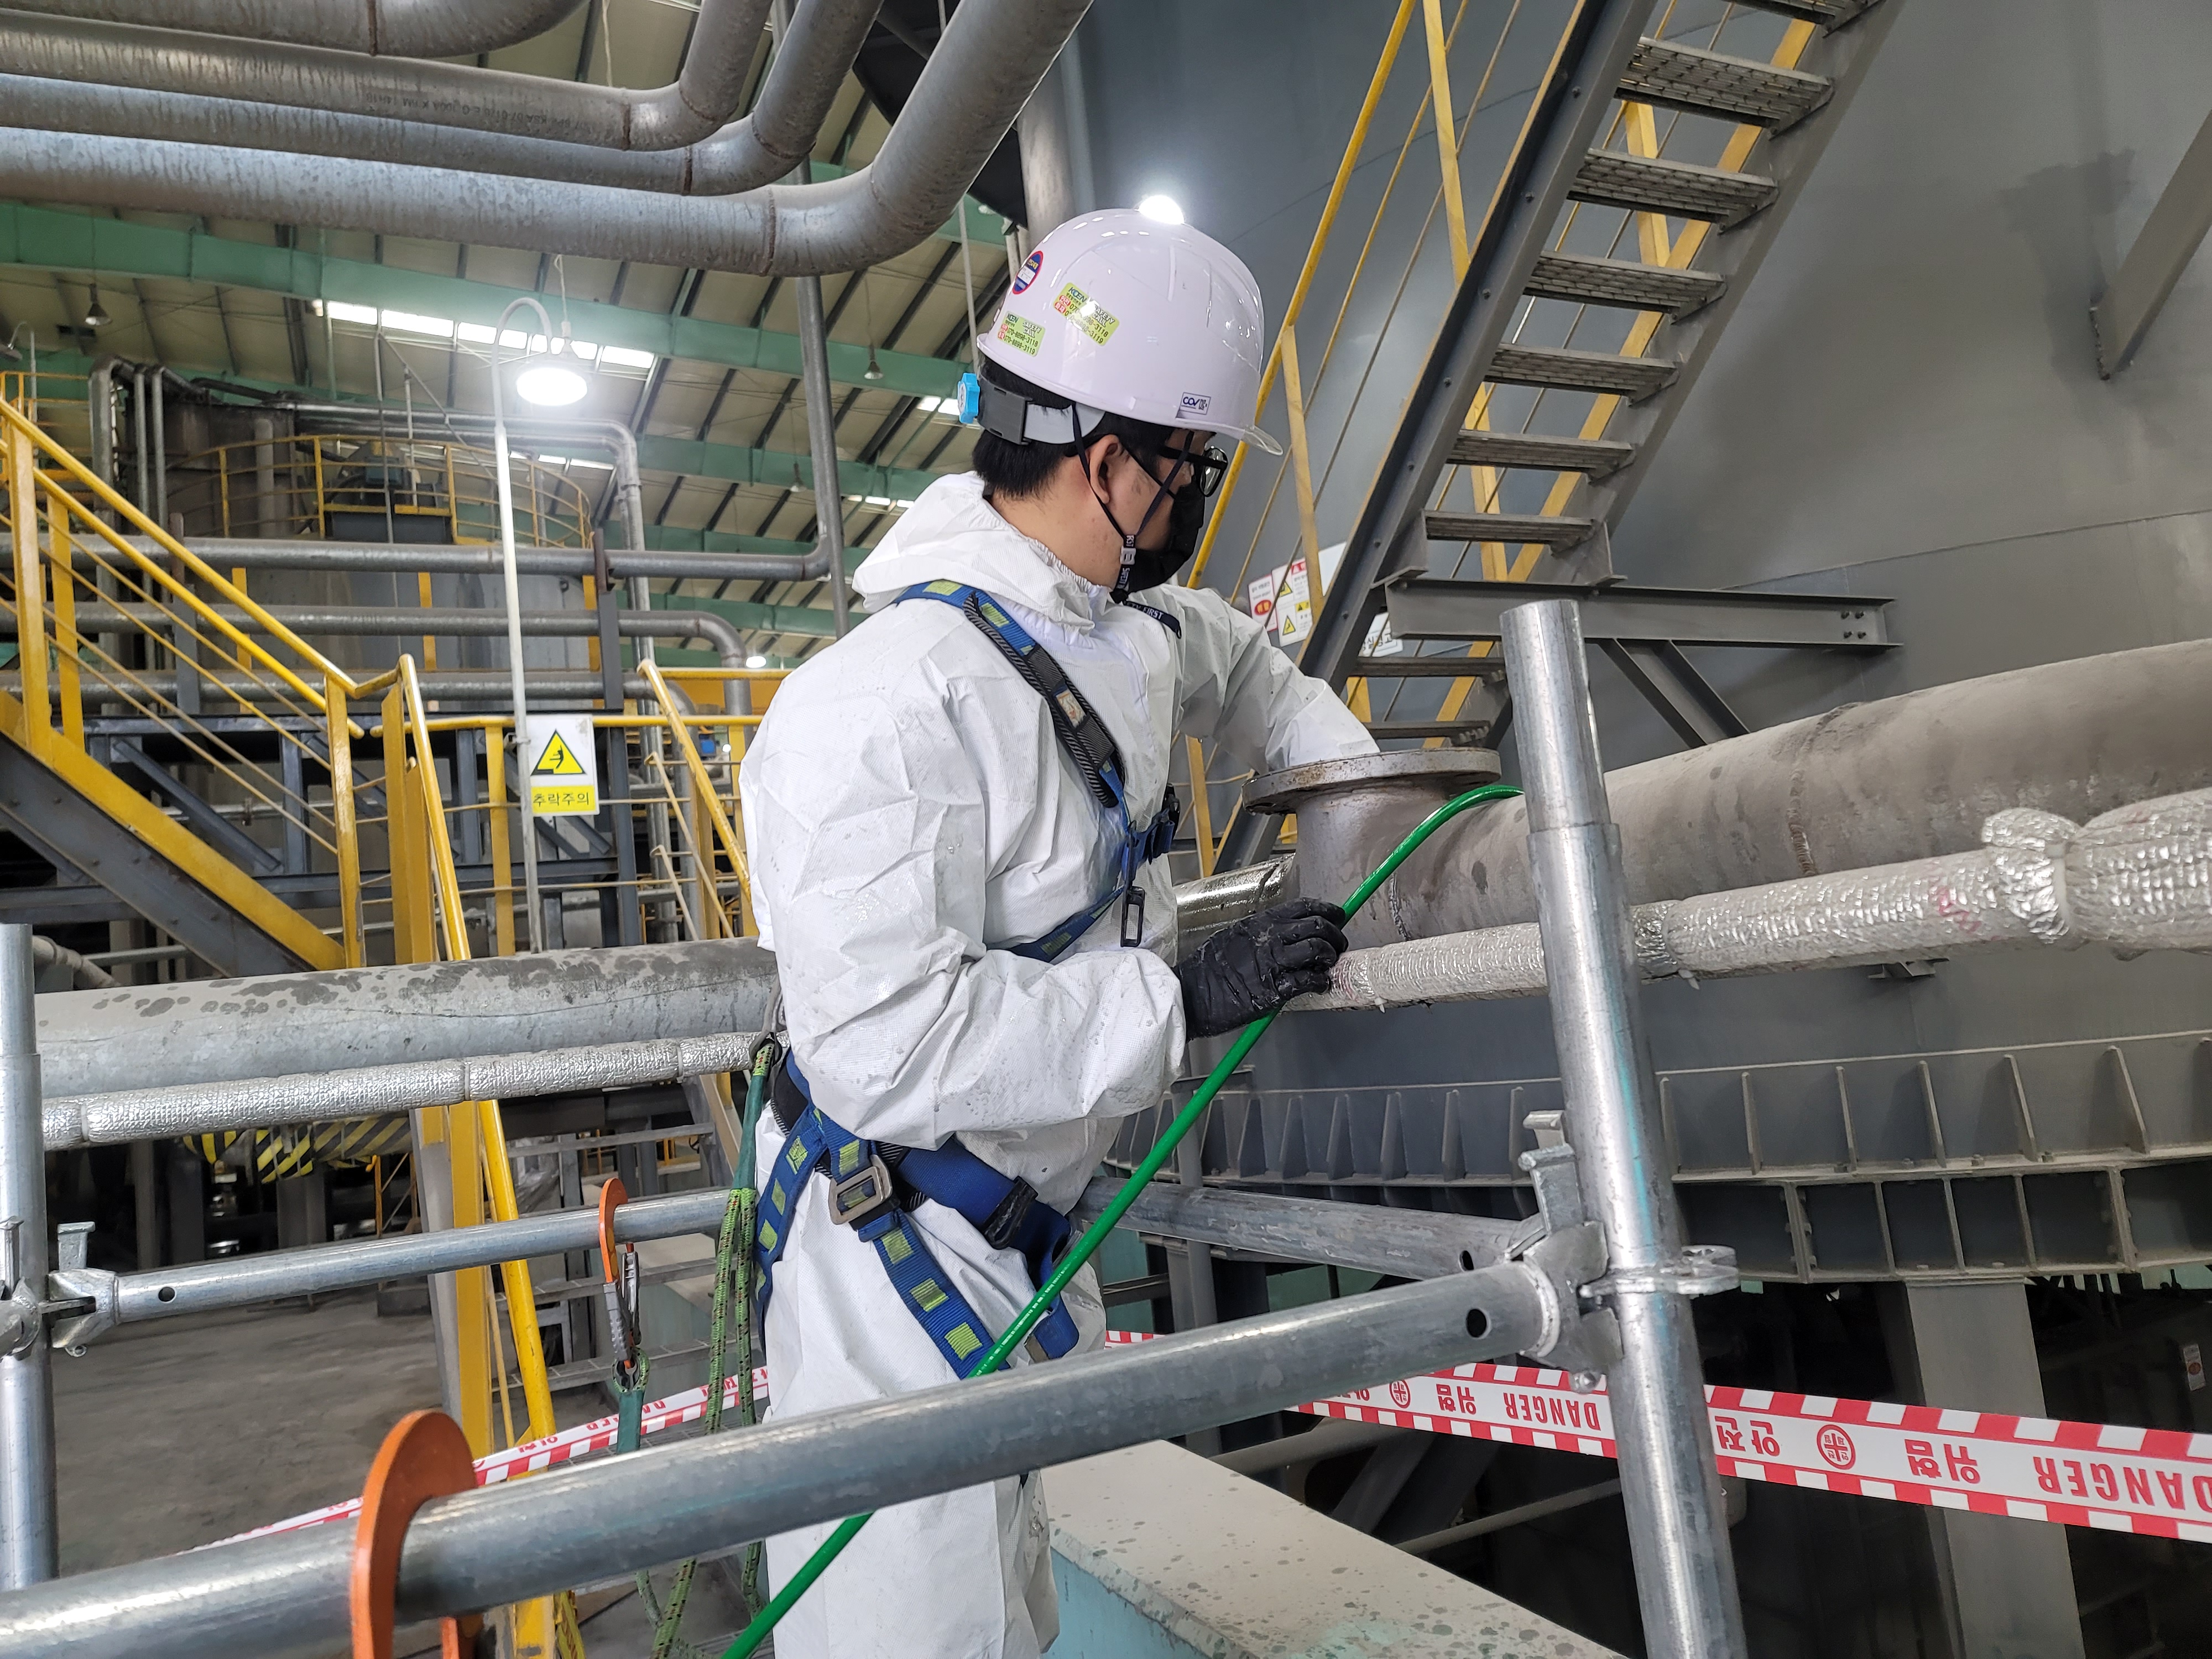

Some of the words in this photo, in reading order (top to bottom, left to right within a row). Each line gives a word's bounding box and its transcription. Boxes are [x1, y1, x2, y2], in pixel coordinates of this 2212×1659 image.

[1022, 321, 1042, 333] SAFETY
[1092, 312, 1107, 327] CALL
[1023, 327, 1035, 338] CALL
[1142, 606, 1164, 620] FIRST
[533, 792, 589, 807] 추락주의
[1436, 1384, 1477, 1415] 위험
[1504, 1392, 1601, 1430] DANGER
[1714, 1416, 1780, 1457] 안전
[1905, 1439, 1980, 1484] 위험
[2033, 1457, 2212, 1513] DANGER
